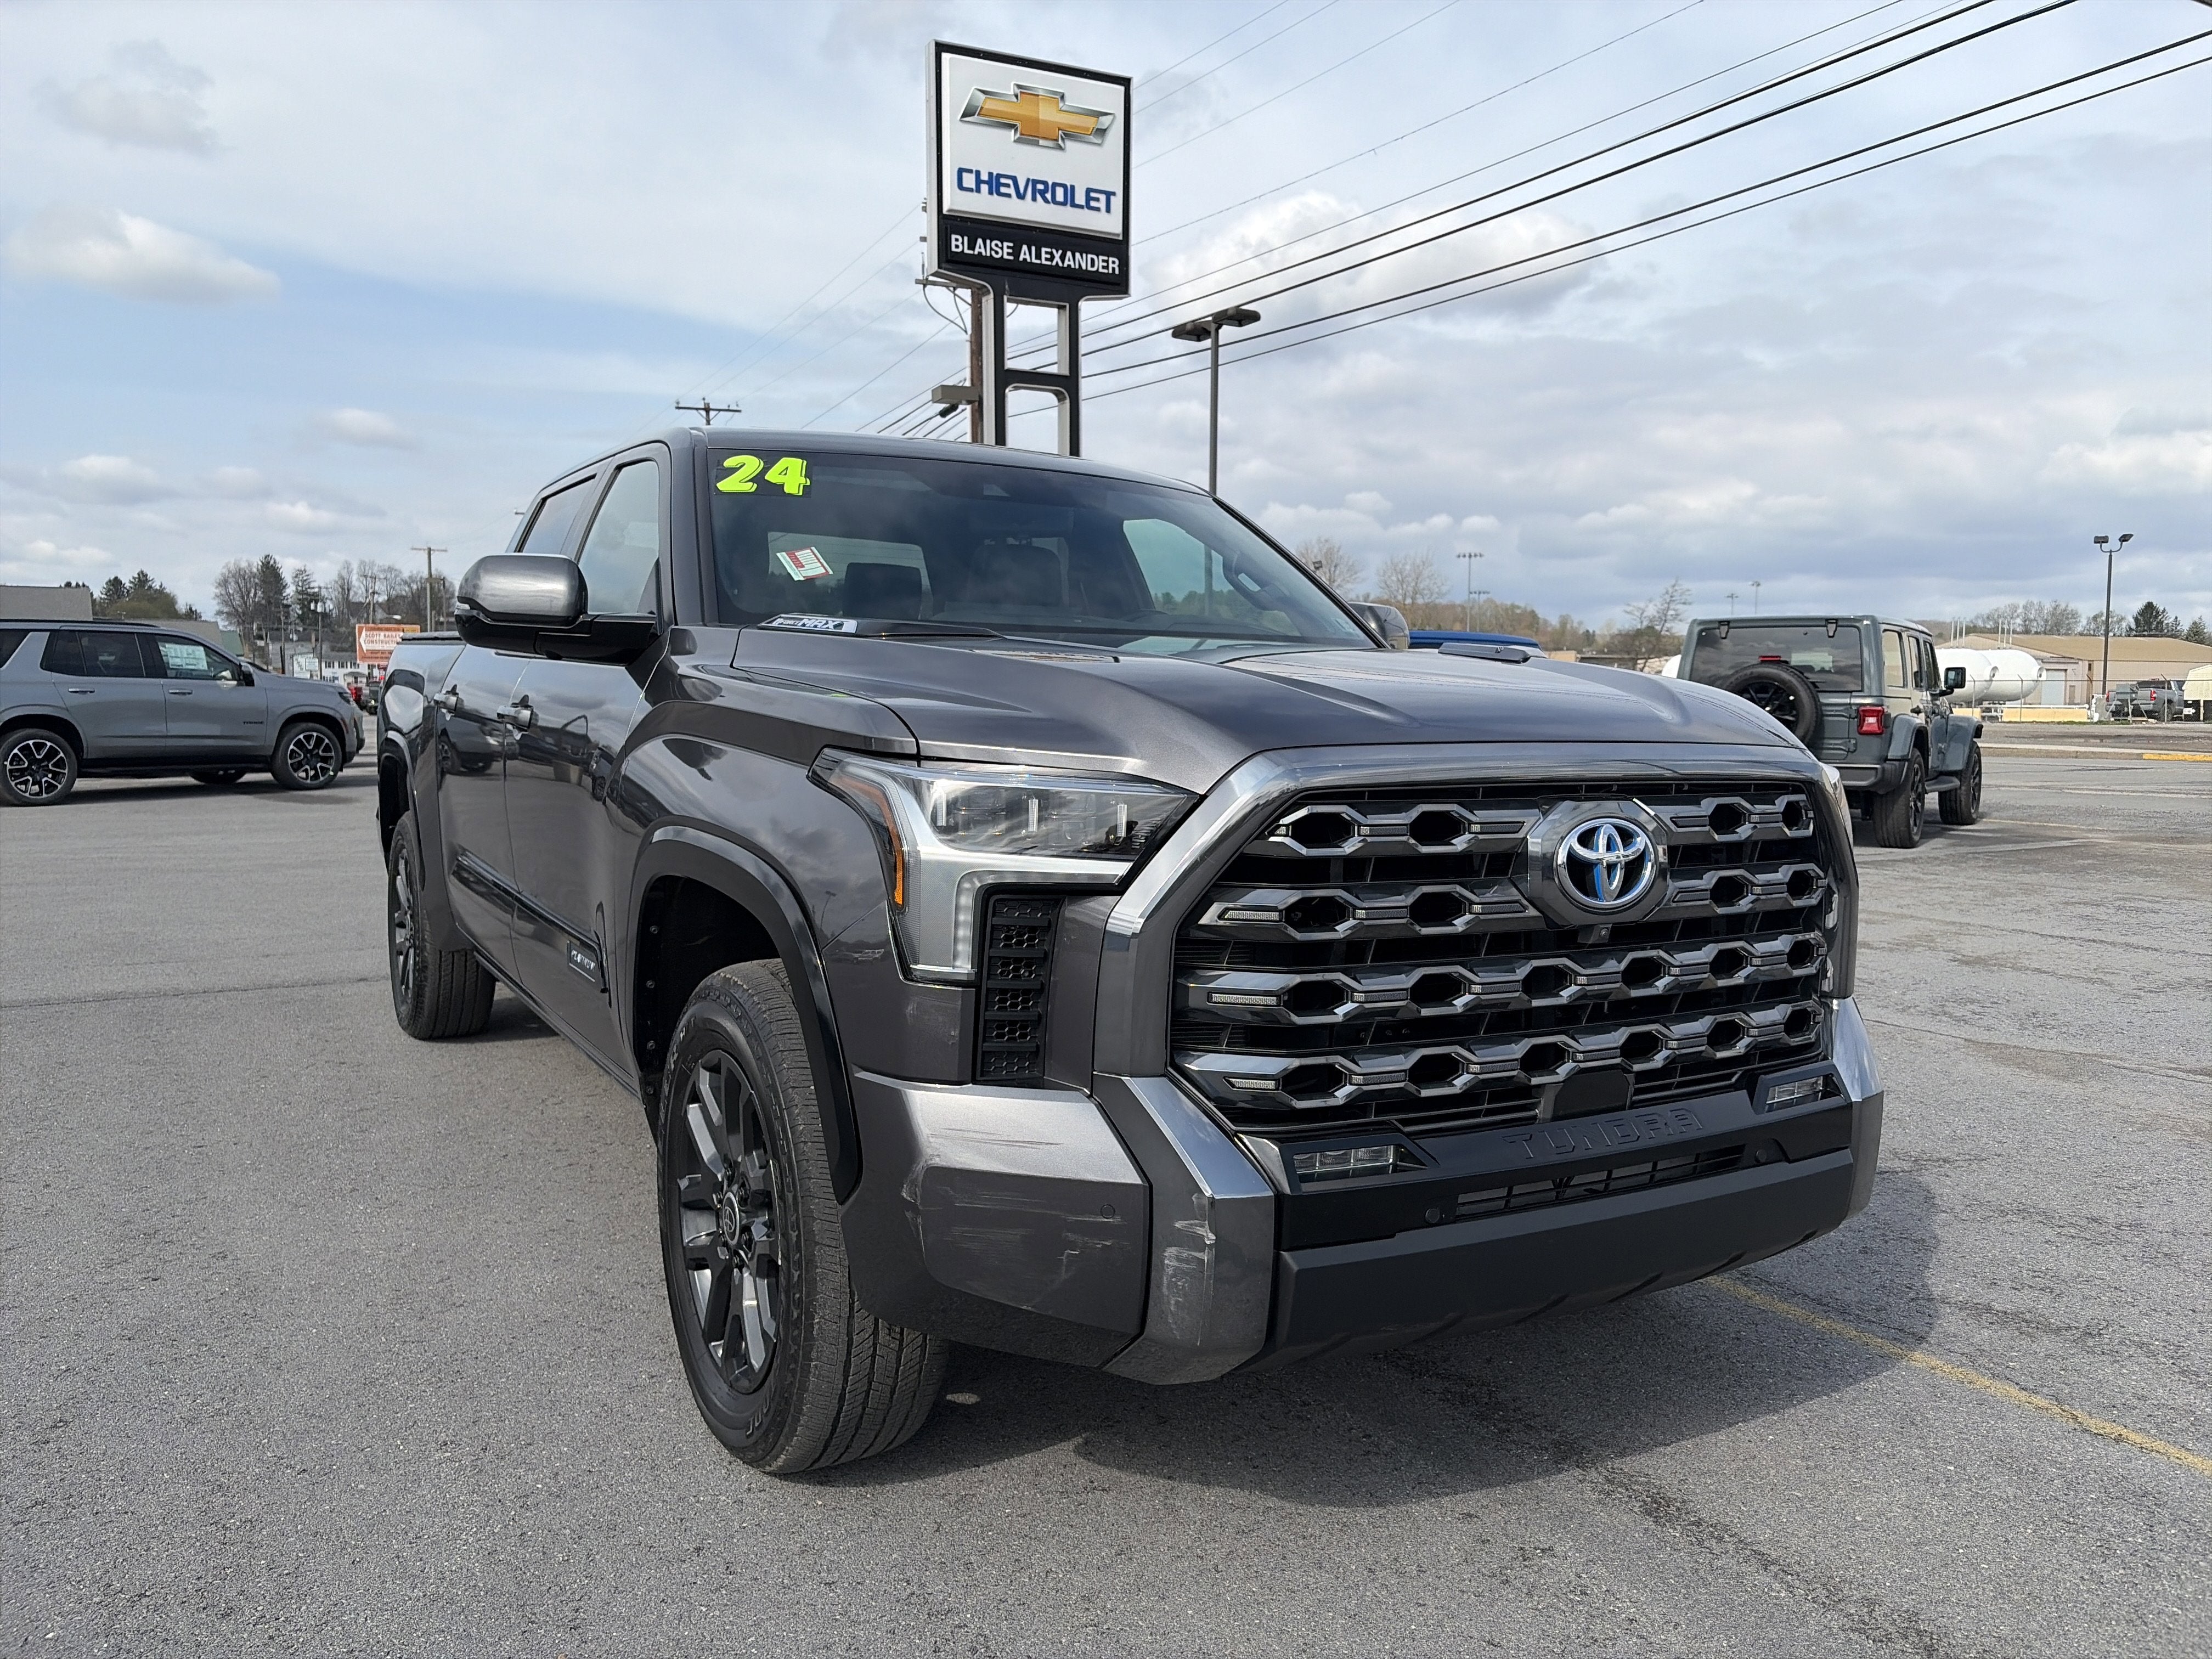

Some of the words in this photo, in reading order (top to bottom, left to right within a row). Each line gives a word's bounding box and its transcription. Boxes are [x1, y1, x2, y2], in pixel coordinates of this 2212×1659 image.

[957, 167, 1117, 214] CHEVROLET
[950, 234, 1014, 261] BLAISE
[1018, 244, 1120, 275] ALEXANDER
[715, 454, 811, 496] 24
[797, 618, 843, 629] MAX
[1501, 1107, 1703, 1160] TUNDRA
